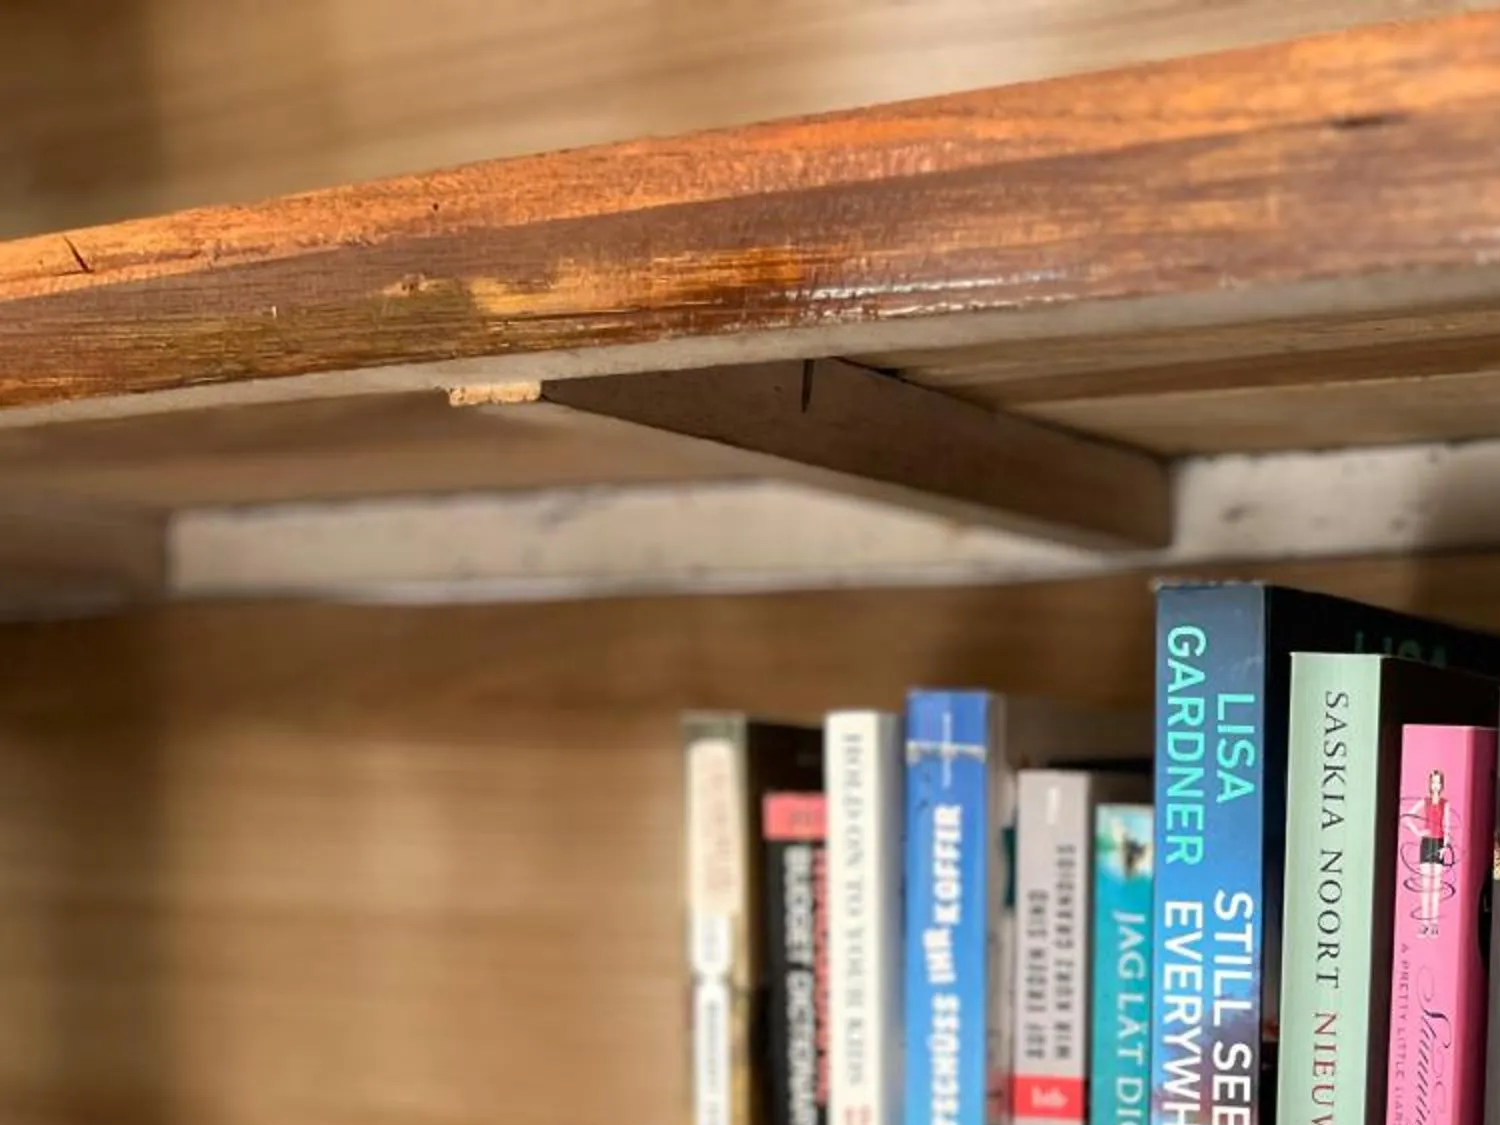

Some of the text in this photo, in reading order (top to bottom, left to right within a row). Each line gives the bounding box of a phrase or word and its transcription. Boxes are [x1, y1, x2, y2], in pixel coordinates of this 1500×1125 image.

[1165, 625, 1207, 865] GARDNER
[1216, 693, 1255, 804] LISA
[932, 804, 962, 926] KOFFER
[1315, 690, 1350, 989] SASKIA NOORT
[1054, 844, 1077, 951] GRANDIOS
[923, 928, 957, 984] IHR
[1053, 957, 1075, 1012] KURZ
[1112, 910, 1147, 980] JAG
[1213, 889, 1254, 1027] STILL
[1397, 958, 1409, 1021] PRETTY
[1117, 993, 1148, 1065] LÅT
[1395, 1026, 1407, 1078] LITTLE
